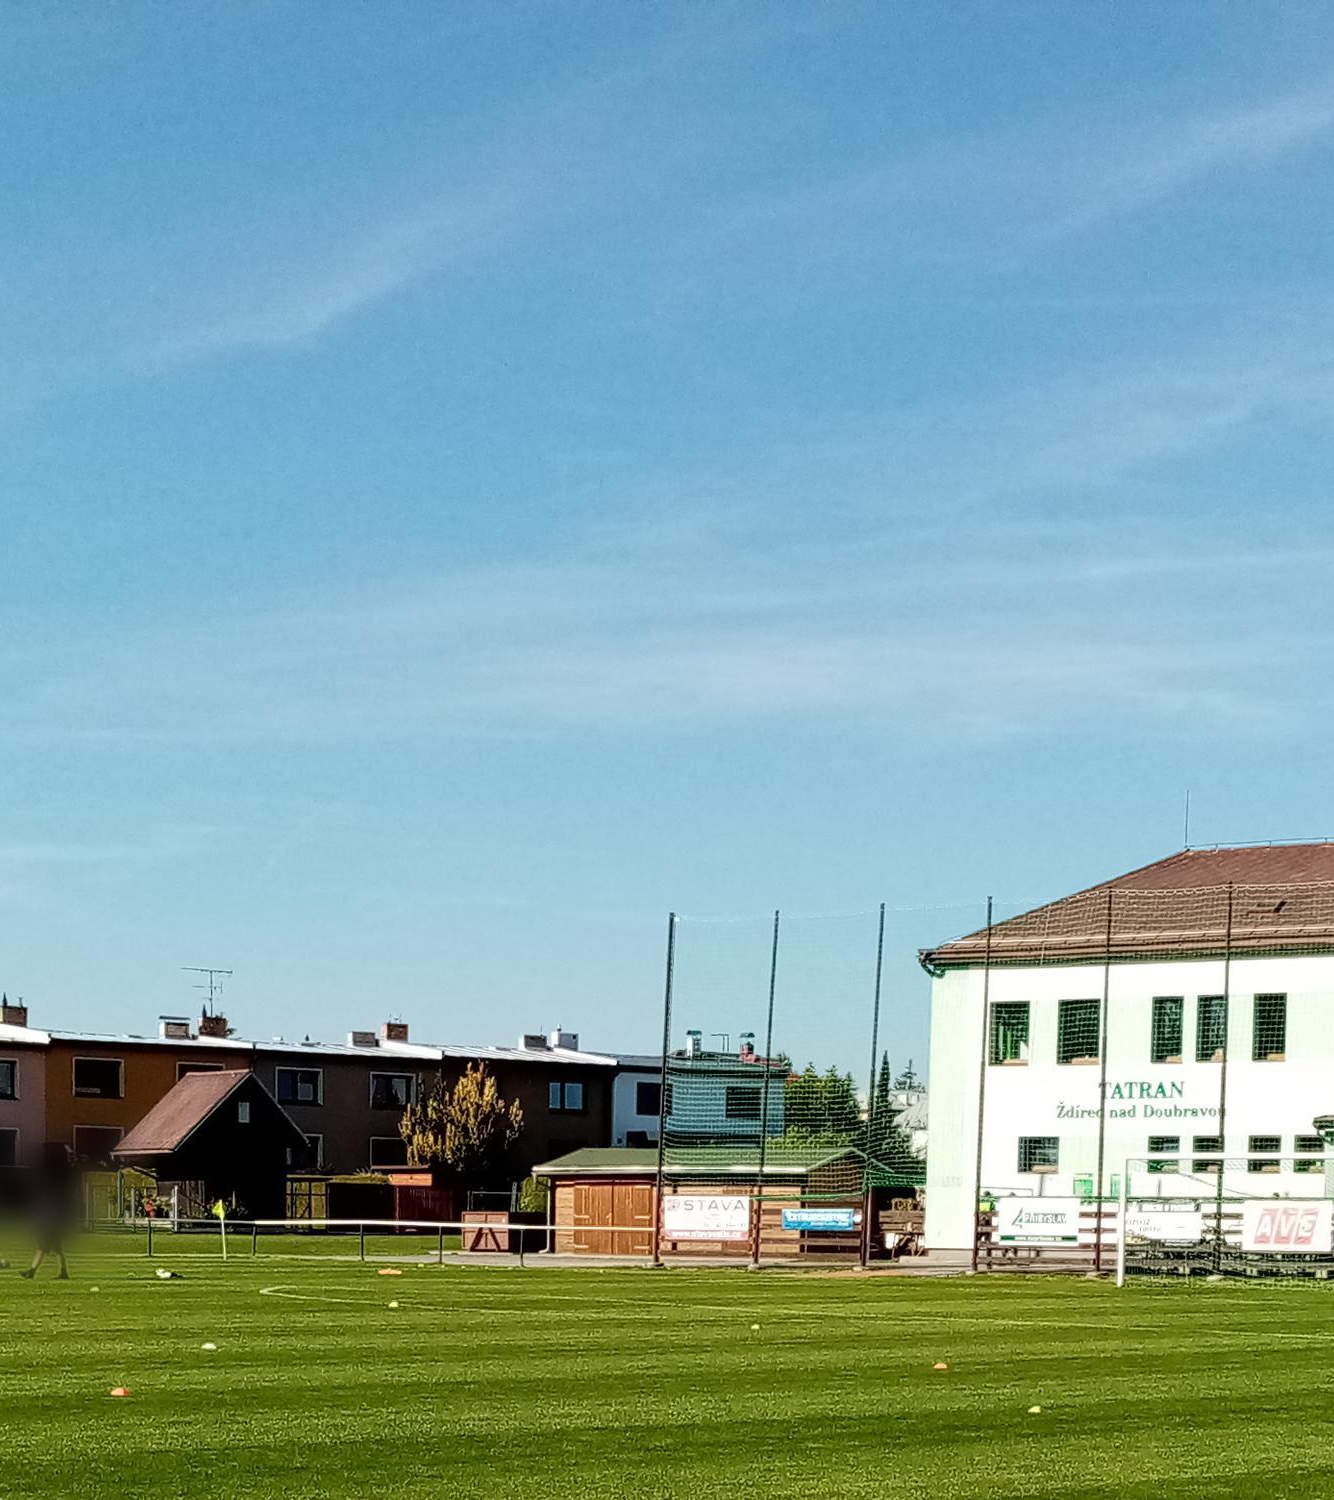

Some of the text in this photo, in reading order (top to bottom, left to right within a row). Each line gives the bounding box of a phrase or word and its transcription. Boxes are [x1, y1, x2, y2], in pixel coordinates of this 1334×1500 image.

[1098, 1081, 1185, 1099] TATRAN
[1057, 1101, 1227, 1118] Ždírec nad Doubravou
[684, 1200, 746, 1211] STAVA
[1254, 1208, 1319, 1244] AVE
